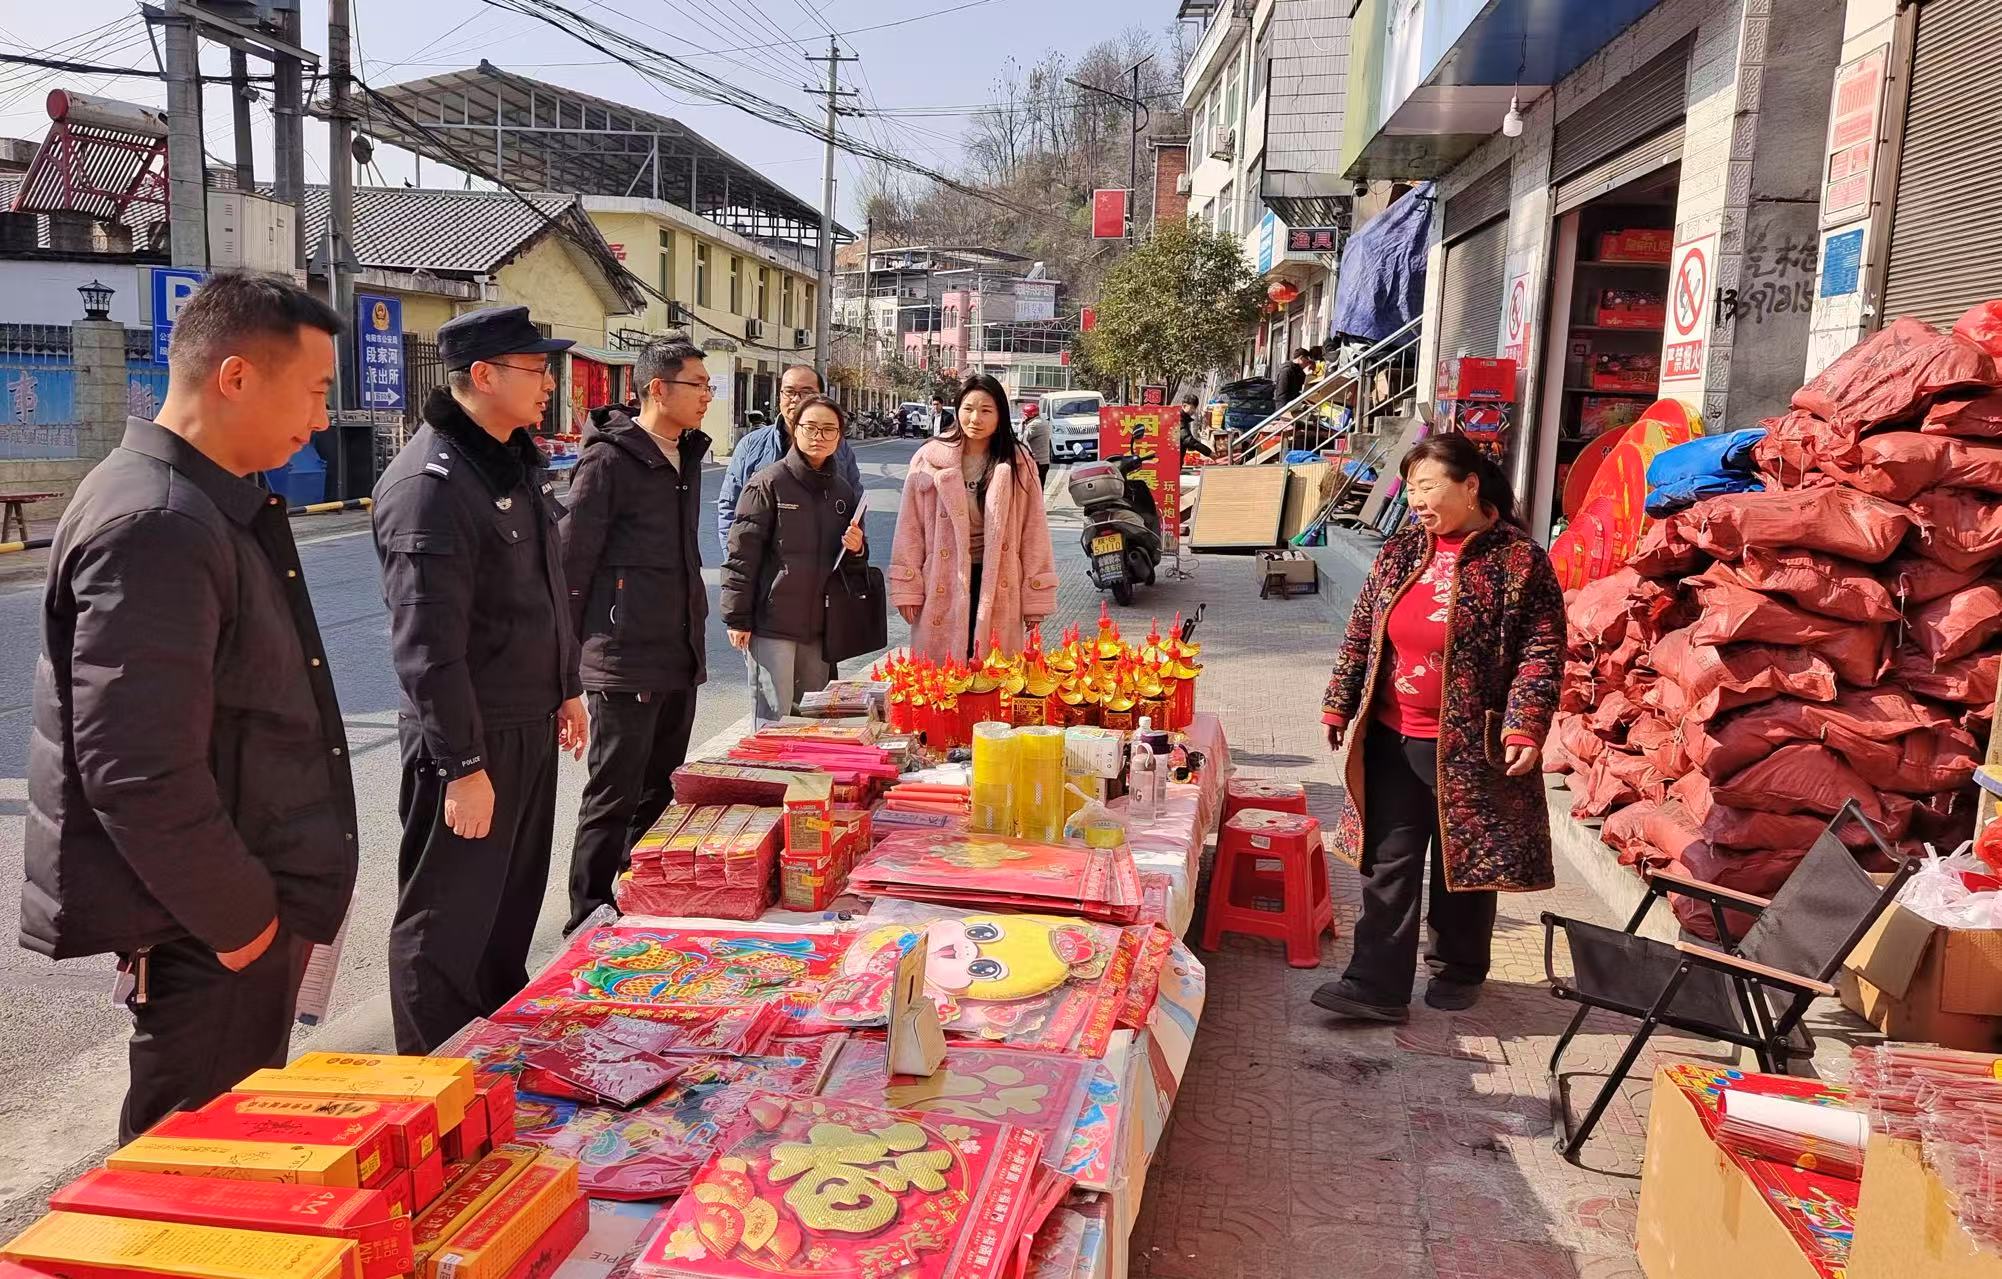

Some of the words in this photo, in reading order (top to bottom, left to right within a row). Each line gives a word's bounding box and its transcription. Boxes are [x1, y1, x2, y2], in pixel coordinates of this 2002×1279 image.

[1291, 231, 1332, 249] 渔具
[165, 275, 202, 322] P
[365, 333, 398, 344] 旬阳市公安局
[365, 346, 399, 364] 段家河
[1664, 343, 1701, 373] 严禁烟火
[365, 367, 400, 385] 派出所
[1163, 480, 1175, 519] 玩具炮
[461, 755, 481, 768] POLICE
[300, 1191, 335, 1215] 4M
